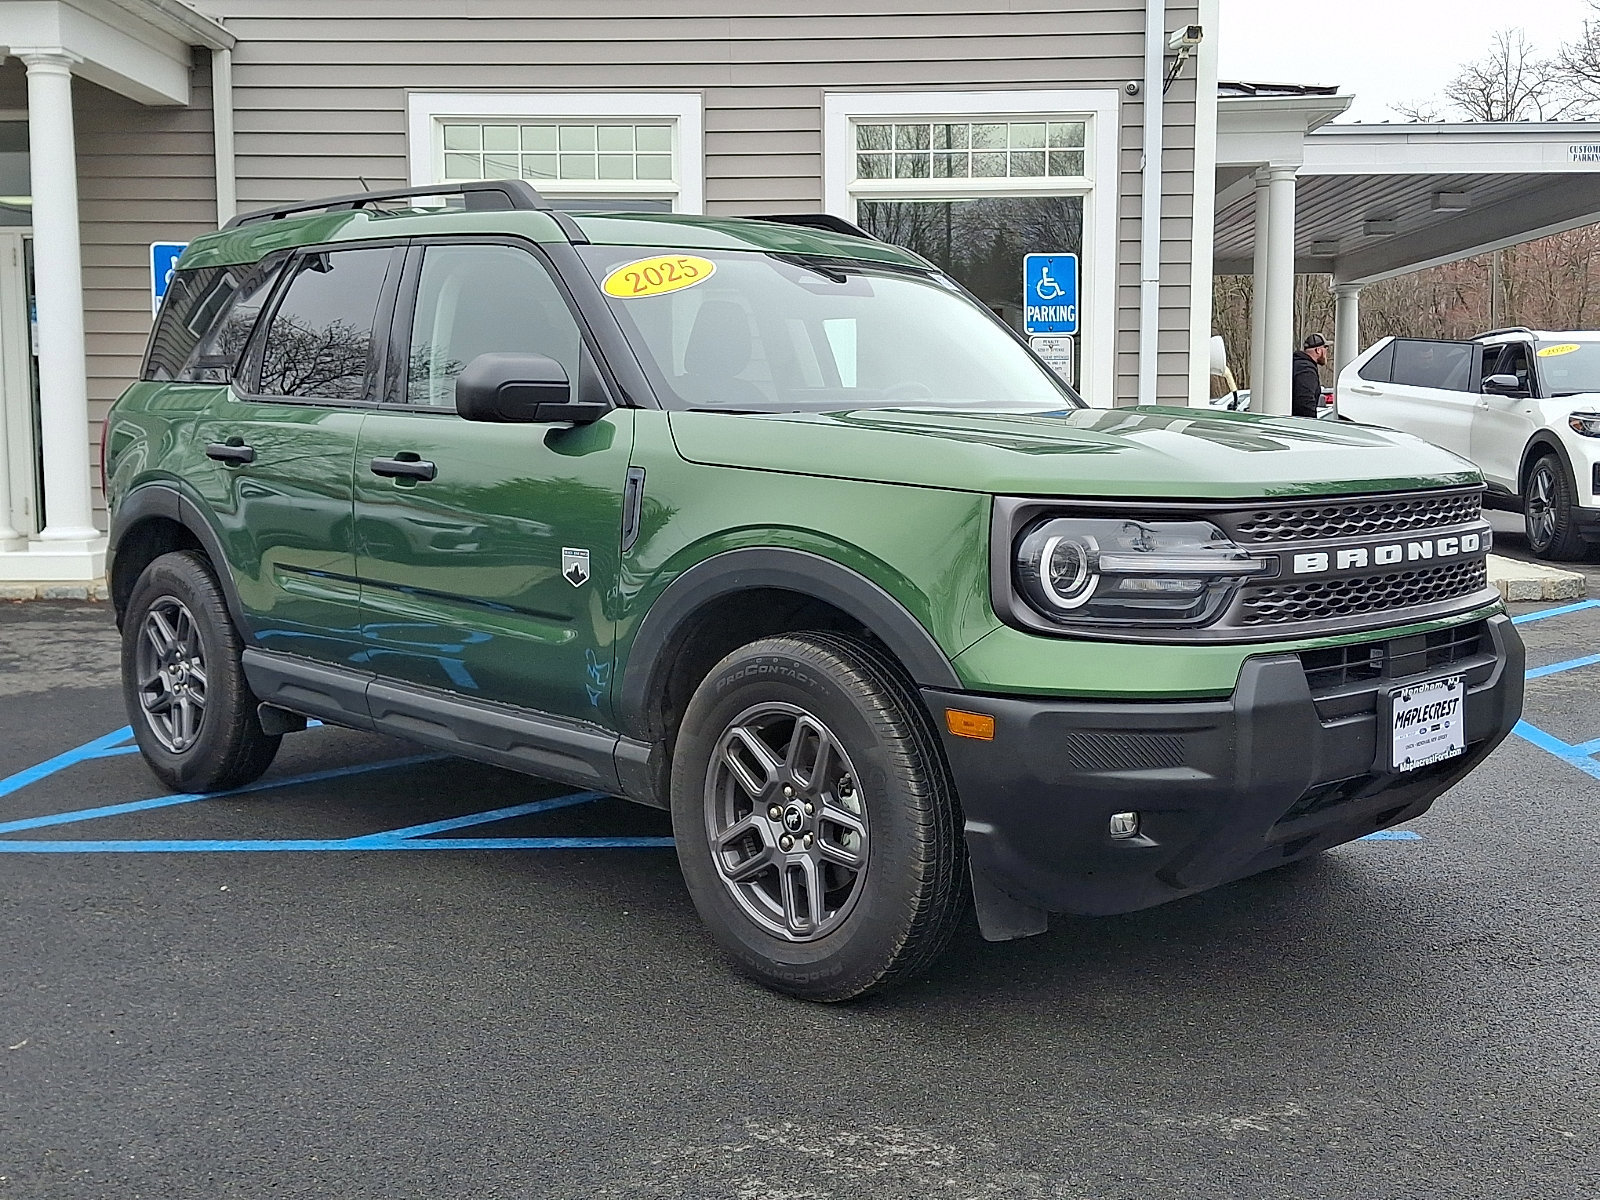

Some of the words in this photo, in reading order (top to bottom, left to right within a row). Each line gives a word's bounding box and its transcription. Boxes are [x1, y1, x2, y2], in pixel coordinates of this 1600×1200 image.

[1569, 145, 1600, 153] CUSTOM
[1573, 153, 1600, 162] PARKIN
[624, 259, 699, 293] 2025
[1027, 305, 1075, 322] PARKING
[1293, 533, 1480, 574] BRONCO
[1447, 677, 1460, 686] NJ
[1394, 698, 1460, 729] MAPLECREST
[1400, 748, 1462, 772] MaplecrestFord.com
